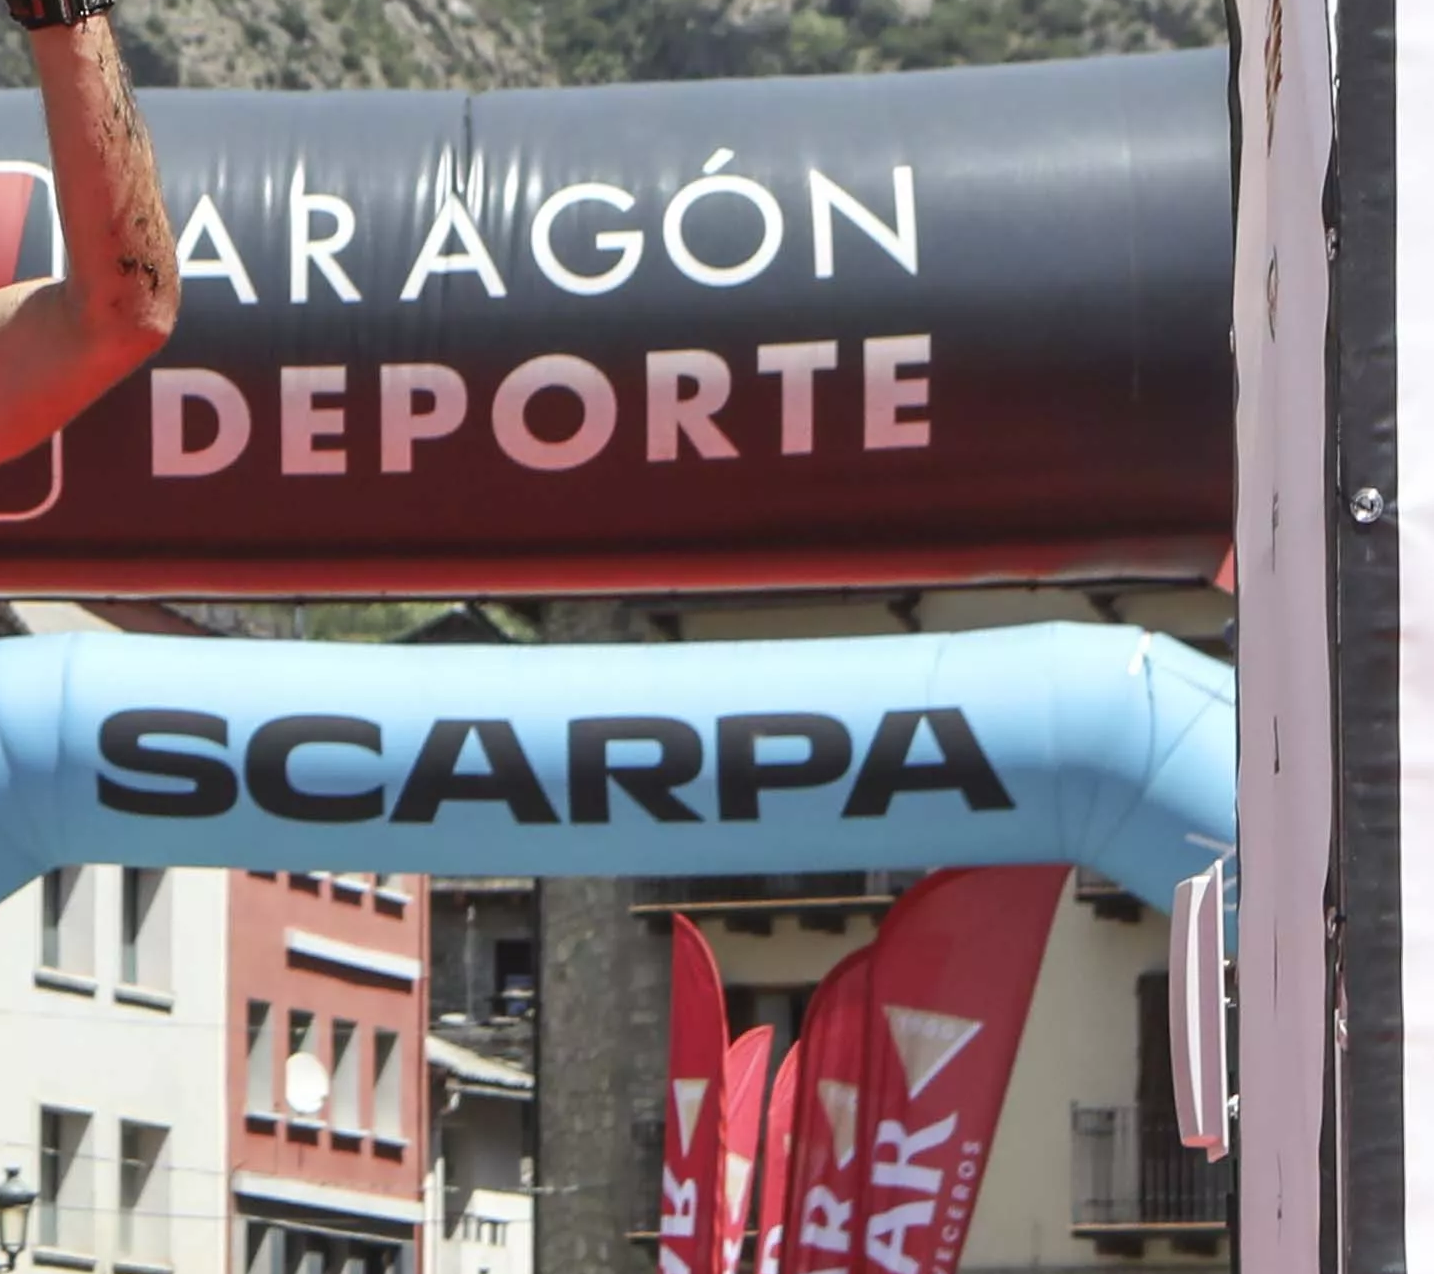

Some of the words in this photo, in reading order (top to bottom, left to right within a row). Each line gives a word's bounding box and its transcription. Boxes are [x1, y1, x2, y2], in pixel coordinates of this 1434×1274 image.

[176, 147, 919, 307] ARAGÓN
[150, 332, 934, 479] DEPORTE
[95, 706, 1017, 826] SCARPA
